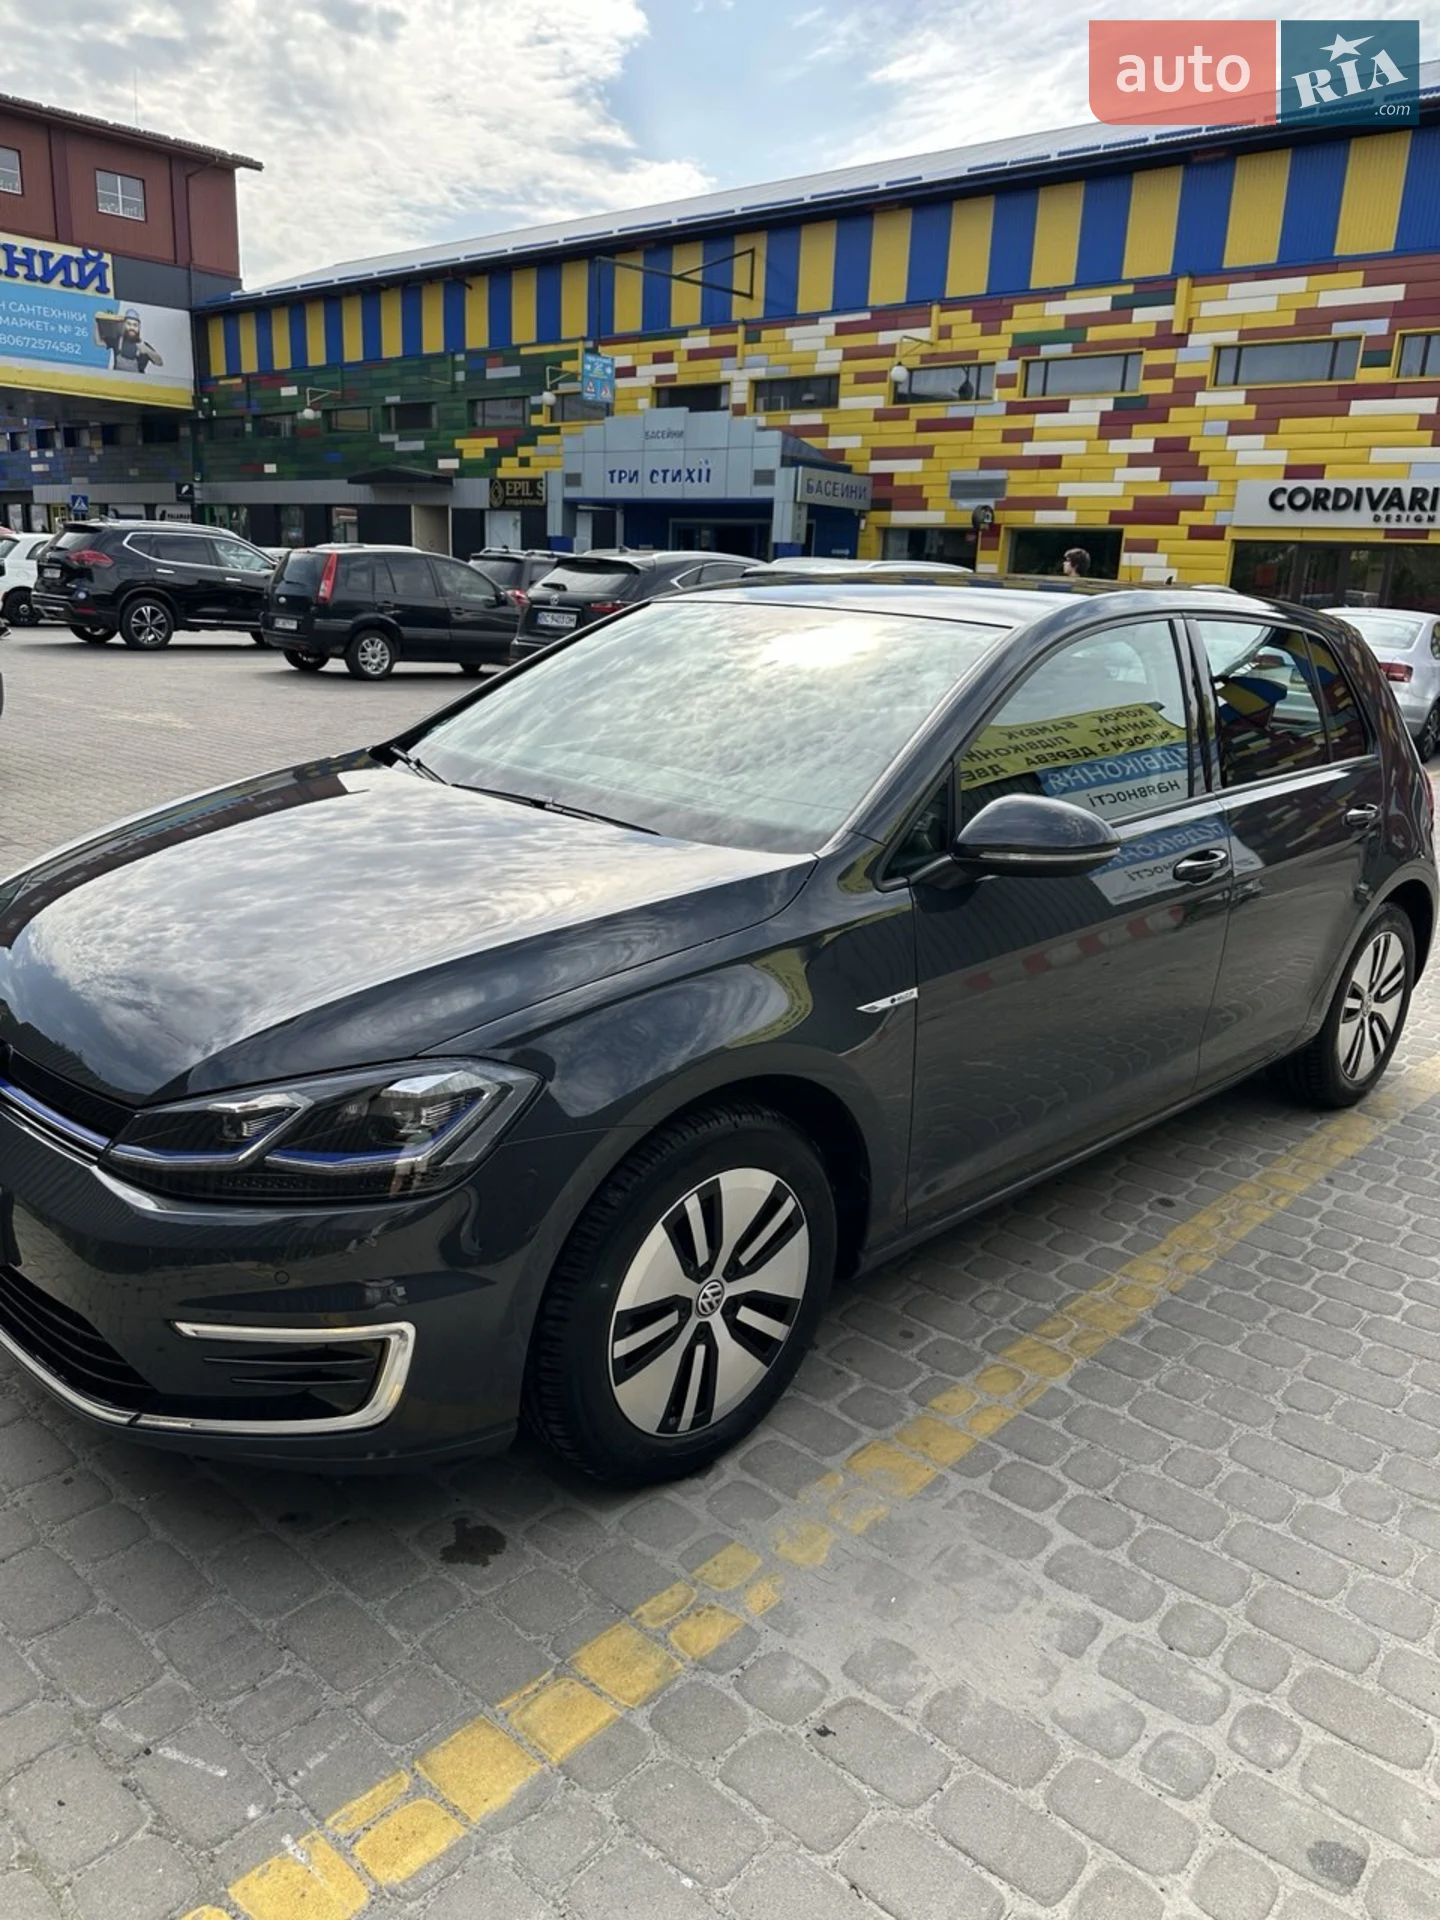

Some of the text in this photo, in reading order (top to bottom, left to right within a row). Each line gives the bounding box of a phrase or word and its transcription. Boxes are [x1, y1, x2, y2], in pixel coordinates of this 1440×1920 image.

[0, 243, 110, 294] НИЙ
[8, 301, 88, 322] САНТЕХНІКИ
[75, 326, 89, 337] 26
[608, 457, 711, 485] ТРИ СТИХІЇ
[505, 480, 533, 496] EPIL
[1268, 486, 1439, 512] CORDIVARI
[1373, 514, 1436, 523] DESIGN
